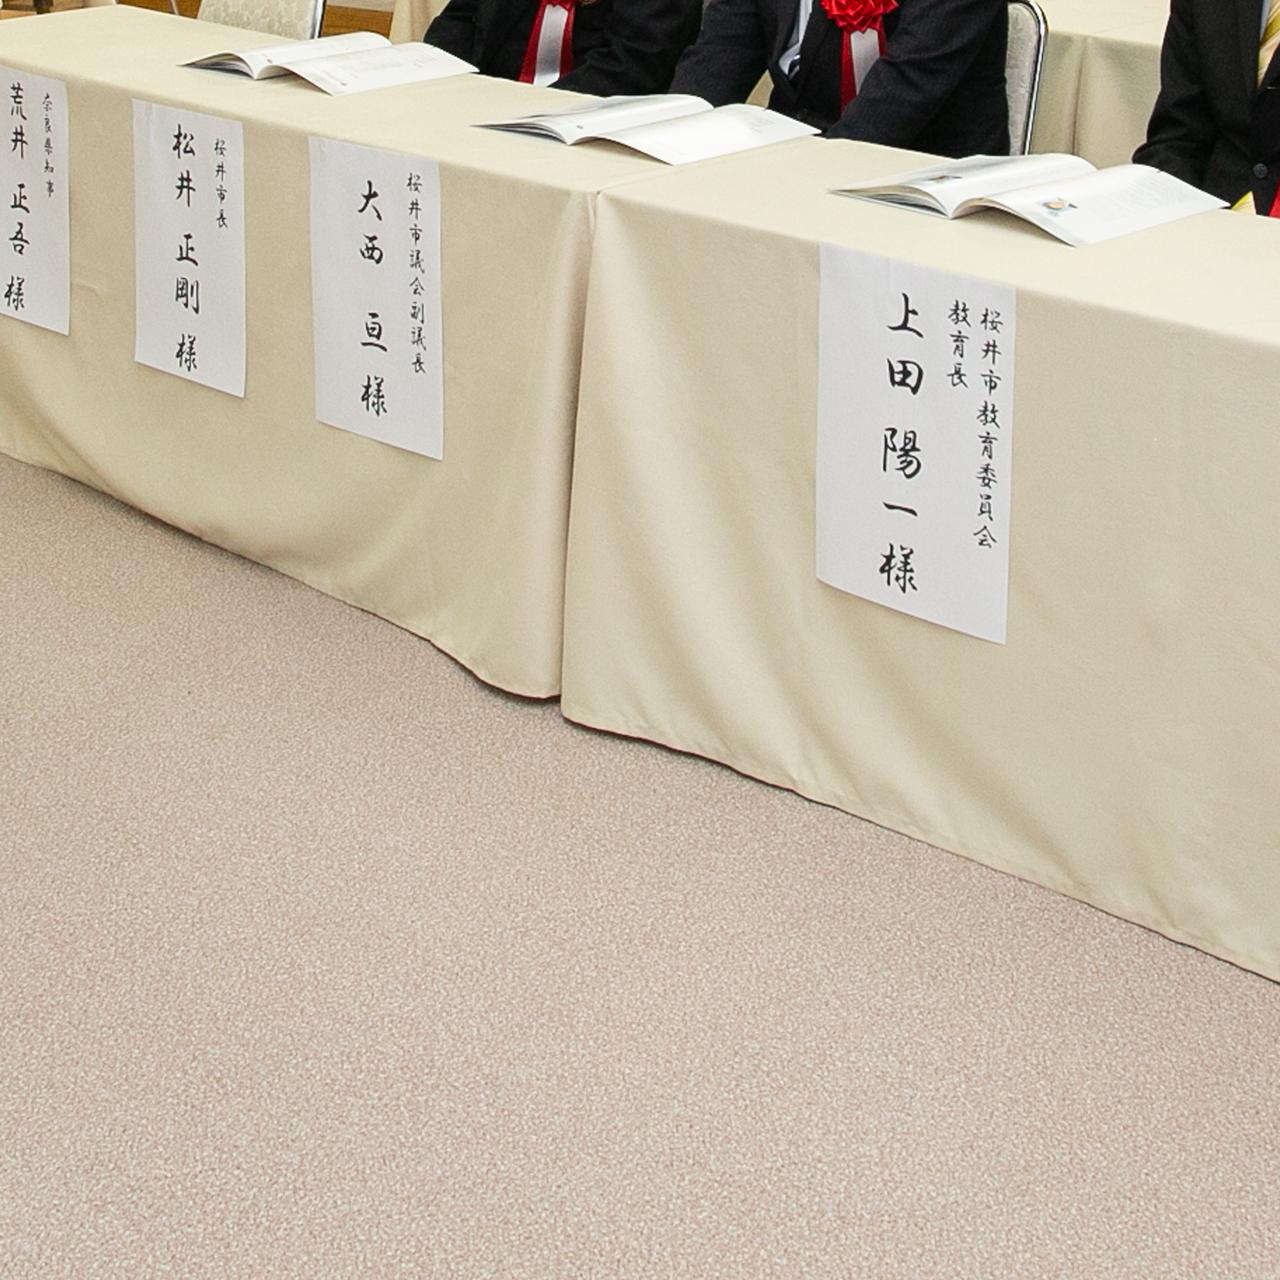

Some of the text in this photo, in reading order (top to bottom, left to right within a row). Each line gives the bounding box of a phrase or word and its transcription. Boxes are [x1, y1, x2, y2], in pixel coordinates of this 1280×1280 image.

[213, 137, 230, 229] 桜井市長
[946, 298, 972, 389] 教育長
[972, 306, 1005, 550] 桜井市教育委員会
